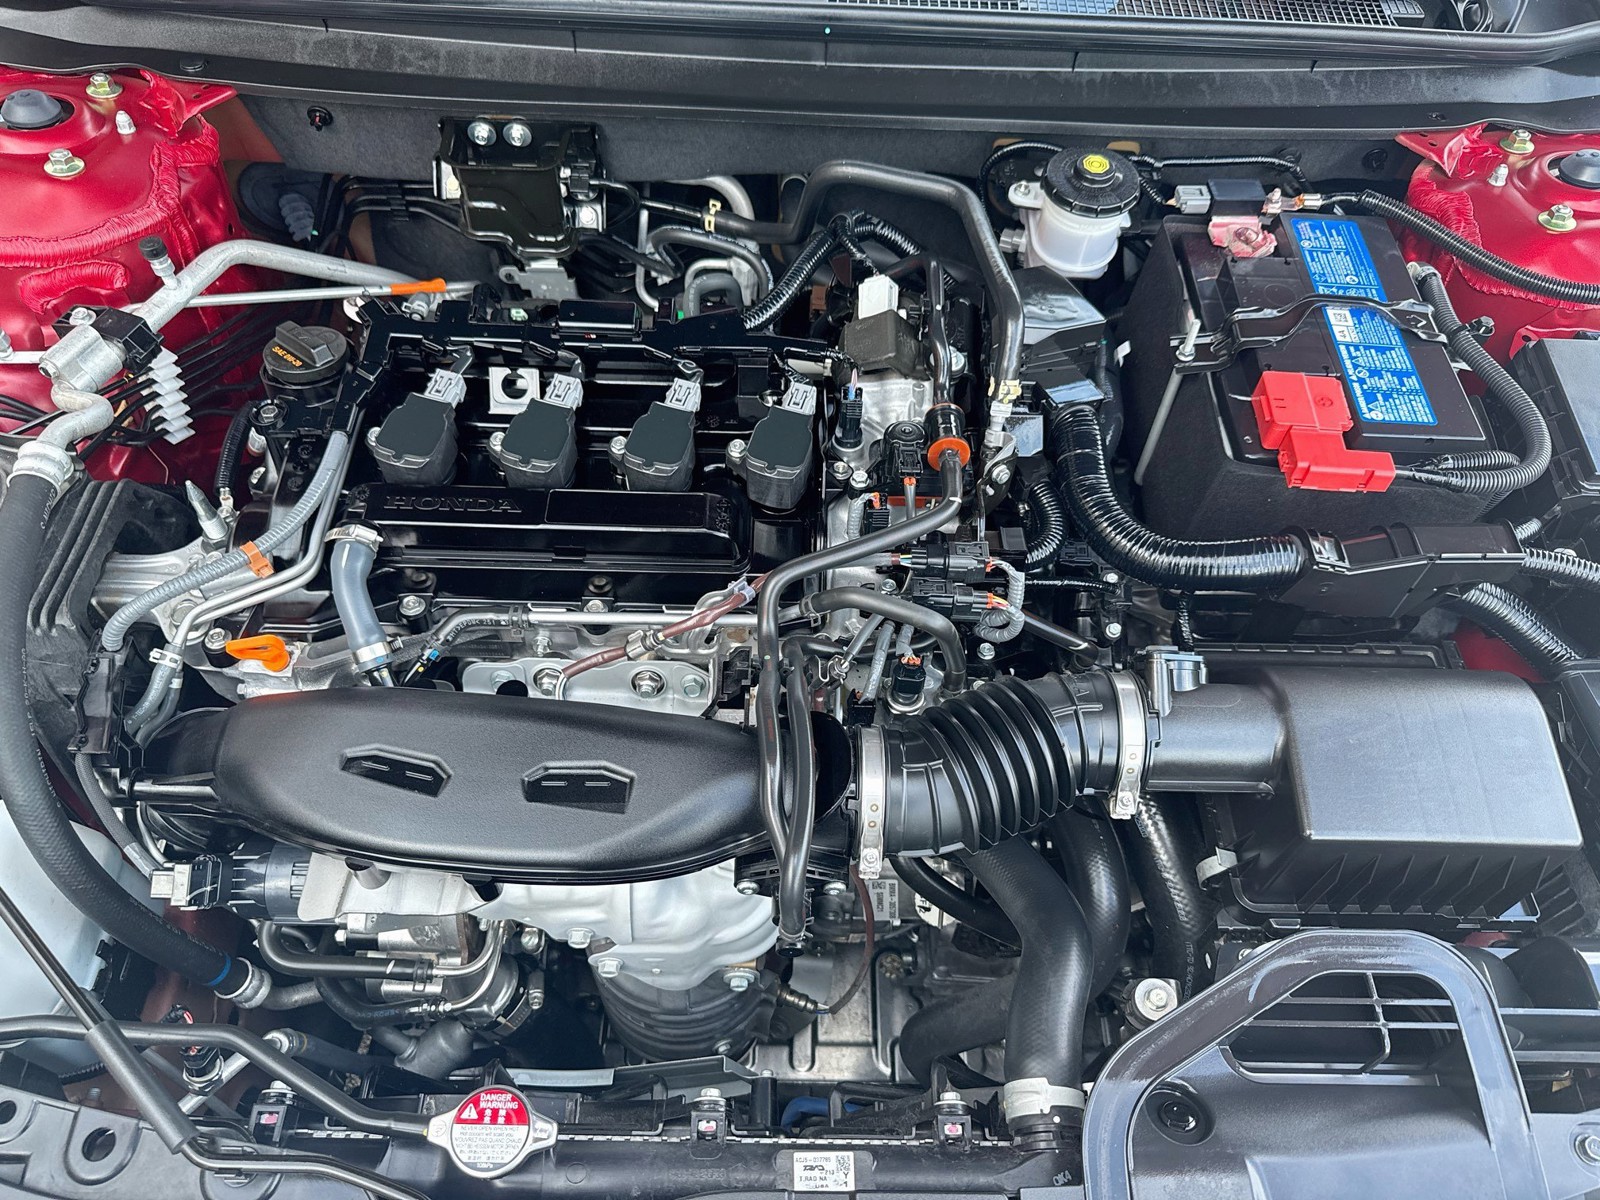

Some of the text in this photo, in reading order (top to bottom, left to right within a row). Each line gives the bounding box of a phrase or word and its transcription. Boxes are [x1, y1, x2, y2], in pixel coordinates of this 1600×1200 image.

[272, 346, 288, 357] SAE
[383, 496, 522, 513] HONDA
[480, 1093, 512, 1101] DANGER
[480, 1101, 518, 1110] WARNUNG
[843, 1171, 850, 1179] Y
